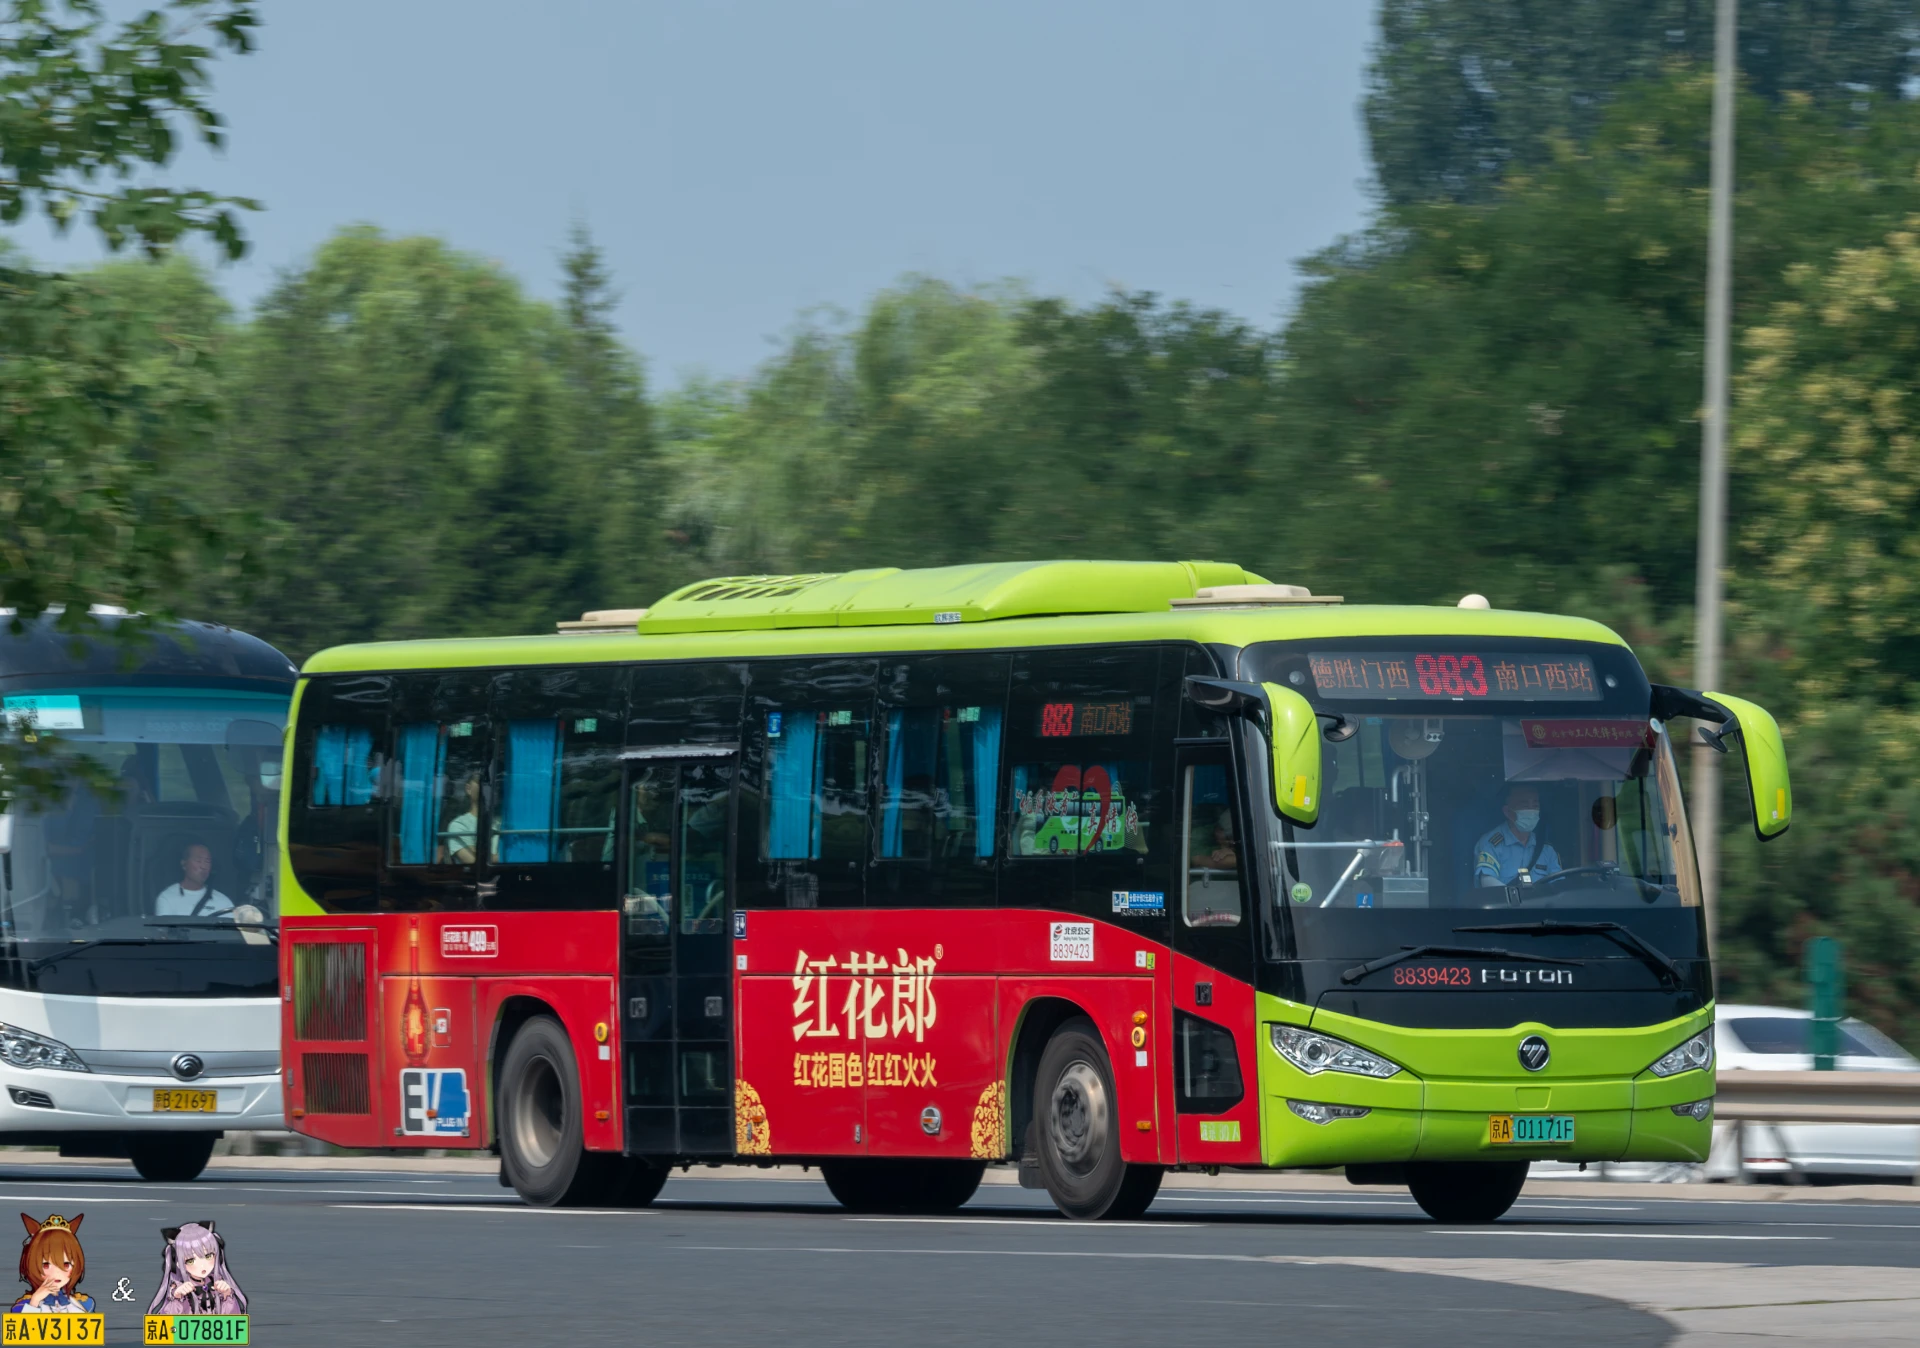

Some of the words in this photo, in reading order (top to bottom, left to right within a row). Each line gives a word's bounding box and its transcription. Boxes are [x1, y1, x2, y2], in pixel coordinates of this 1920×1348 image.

[1309, 657, 1411, 690] 德胜门西
[1414, 653, 1489, 696] 883
[1493, 661, 1594, 692] 南口西站
[1041, 703, 1075, 737] 883
[1080, 701, 1131, 735] 南口西站
[1064, 926, 1091, 936] 北京公交
[1053, 943, 1090, 959] 8839423
[1393, 967, 1471, 985] 8839423
[792, 947, 937, 1042] 红花郎
[793, 1052, 864, 1088] 红花国色
[867, 1052, 938, 1088] 红红火火
